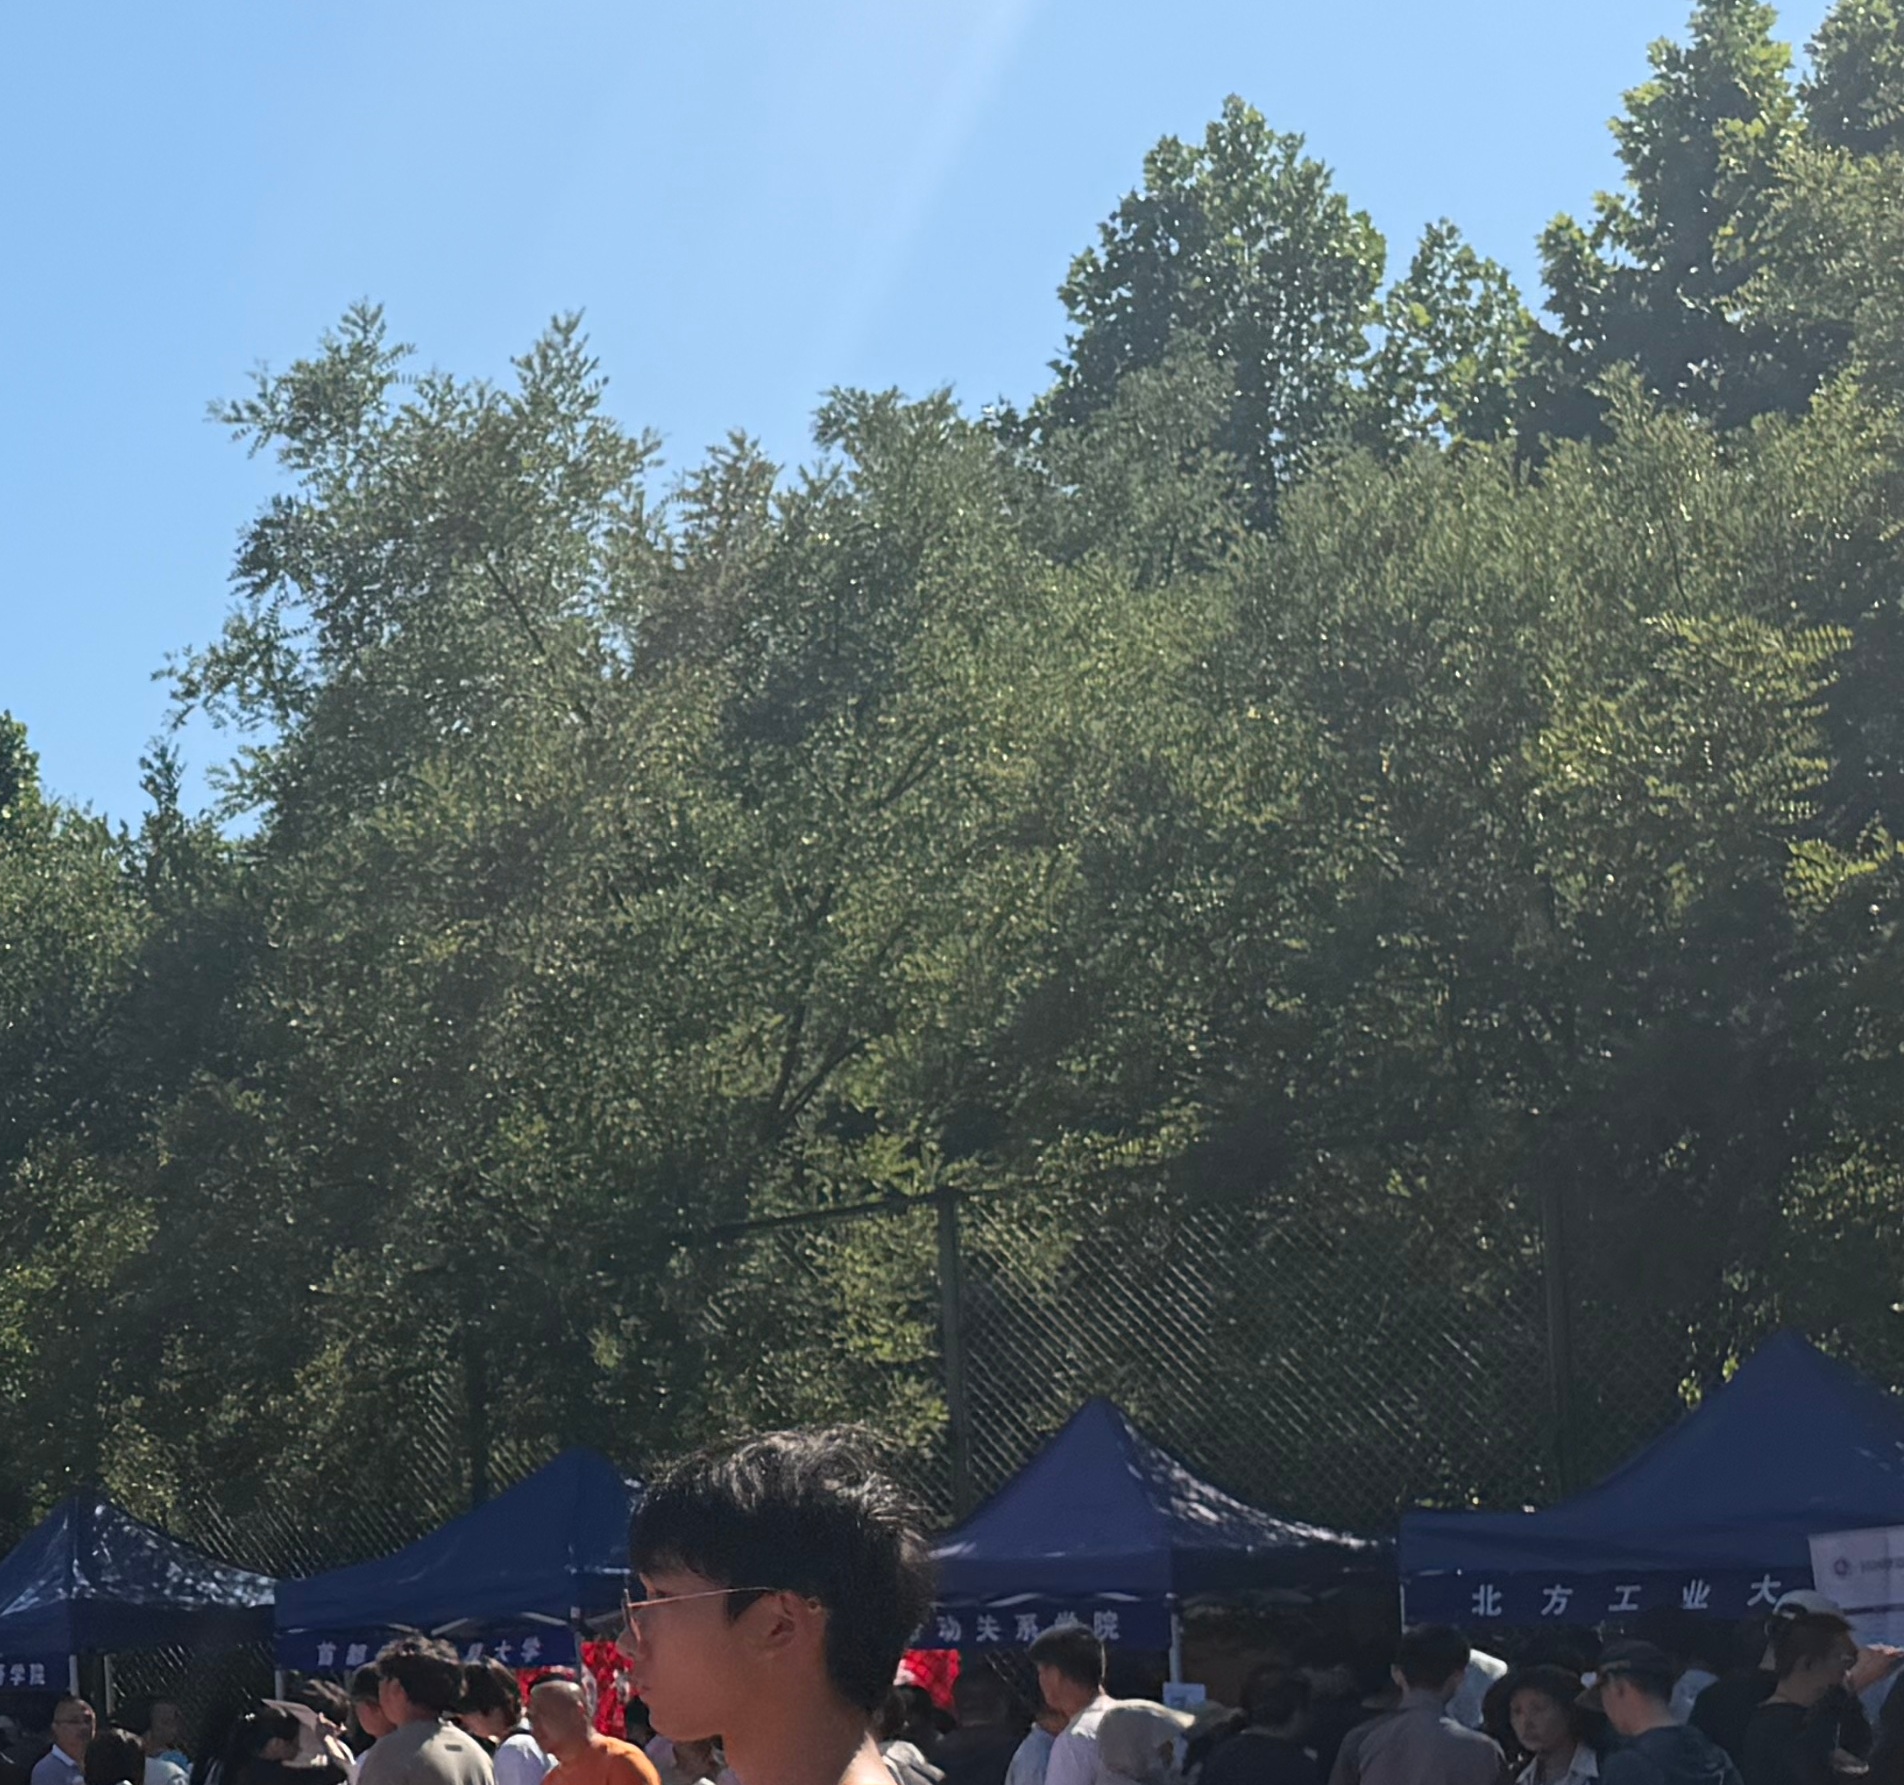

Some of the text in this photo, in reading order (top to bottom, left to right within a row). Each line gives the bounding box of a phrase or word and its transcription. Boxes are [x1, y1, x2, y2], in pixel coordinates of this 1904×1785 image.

[1471, 1573, 1782, 1617] 北方工业大
